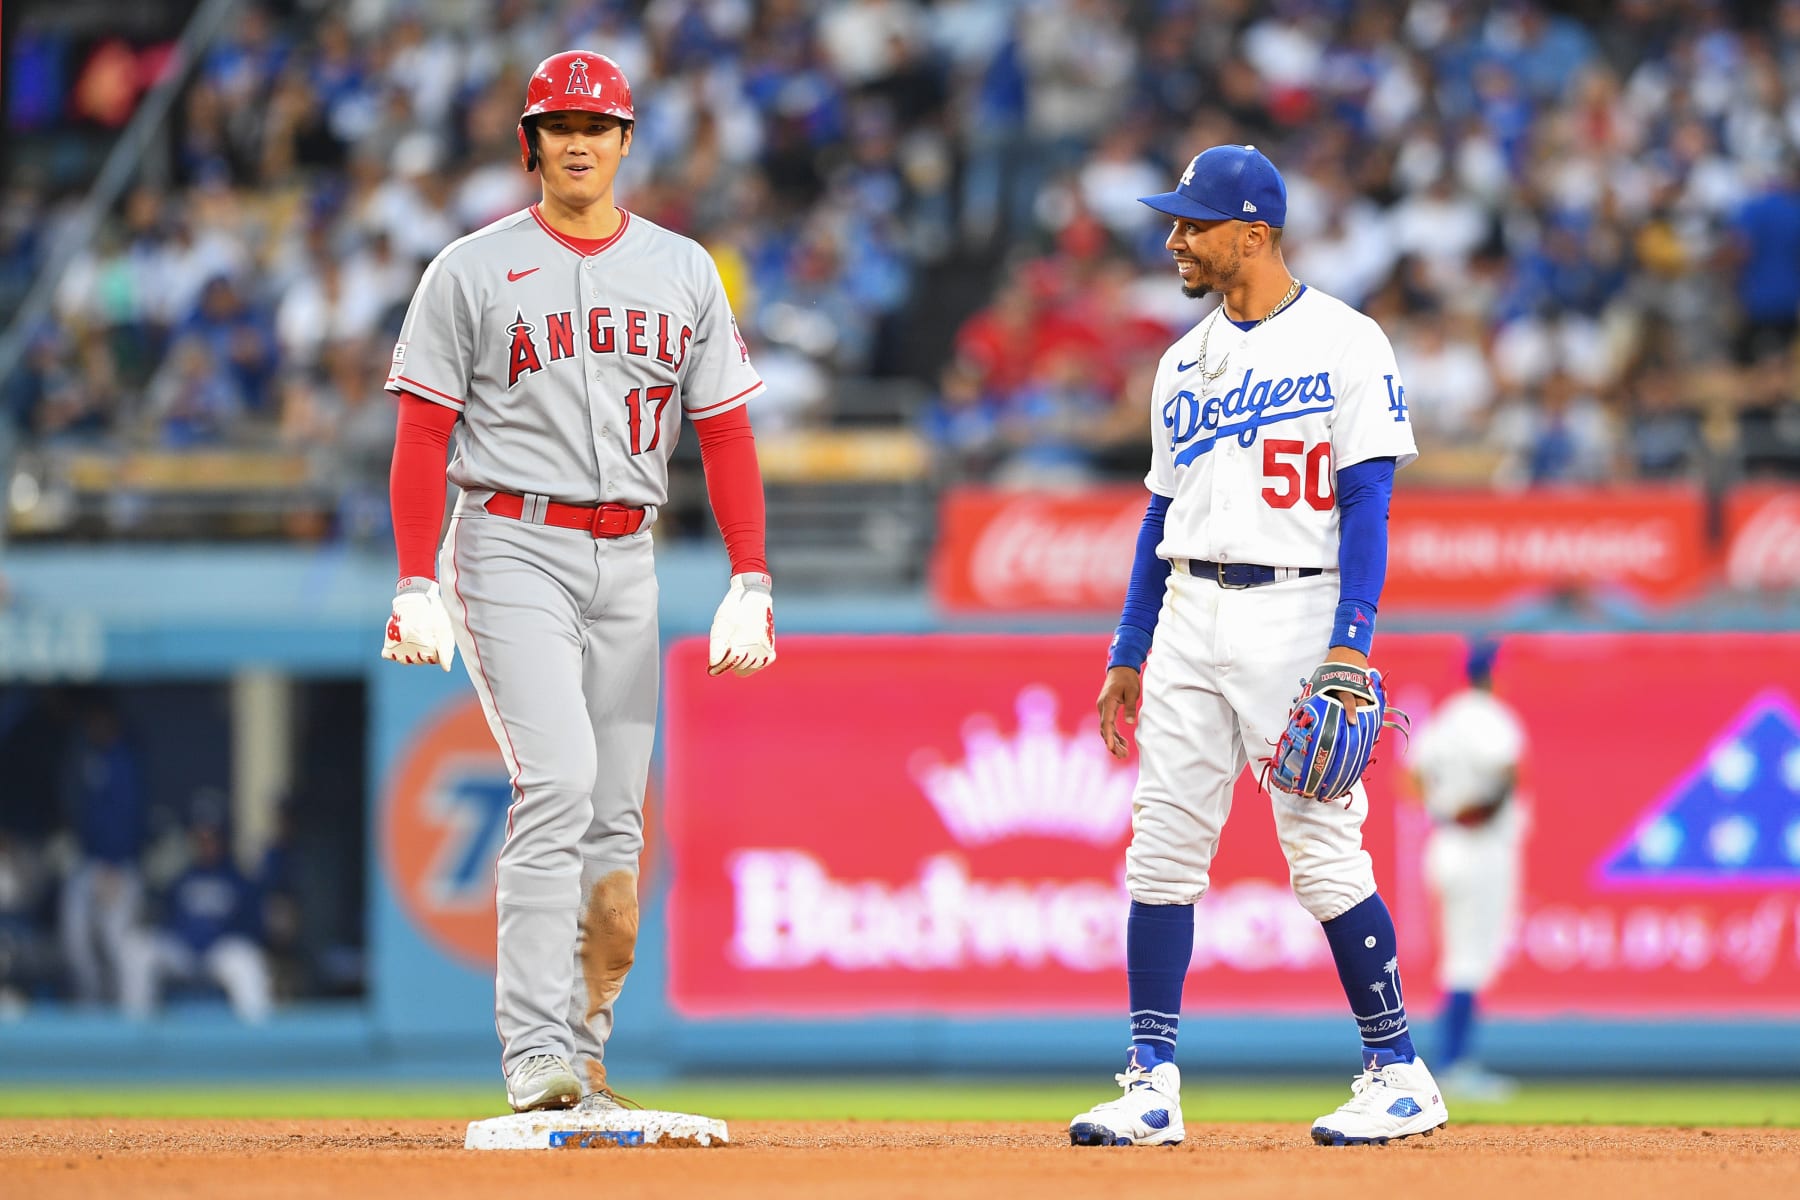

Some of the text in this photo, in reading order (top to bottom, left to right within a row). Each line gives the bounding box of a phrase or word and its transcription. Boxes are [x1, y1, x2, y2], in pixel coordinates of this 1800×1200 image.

[565, 58, 592, 95] A
[504, 305, 692, 390] ANGELS
[624, 385, 675, 456] 17
[1163, 369, 1334, 451] Dodgers
[1261, 438, 1336, 512] 50
